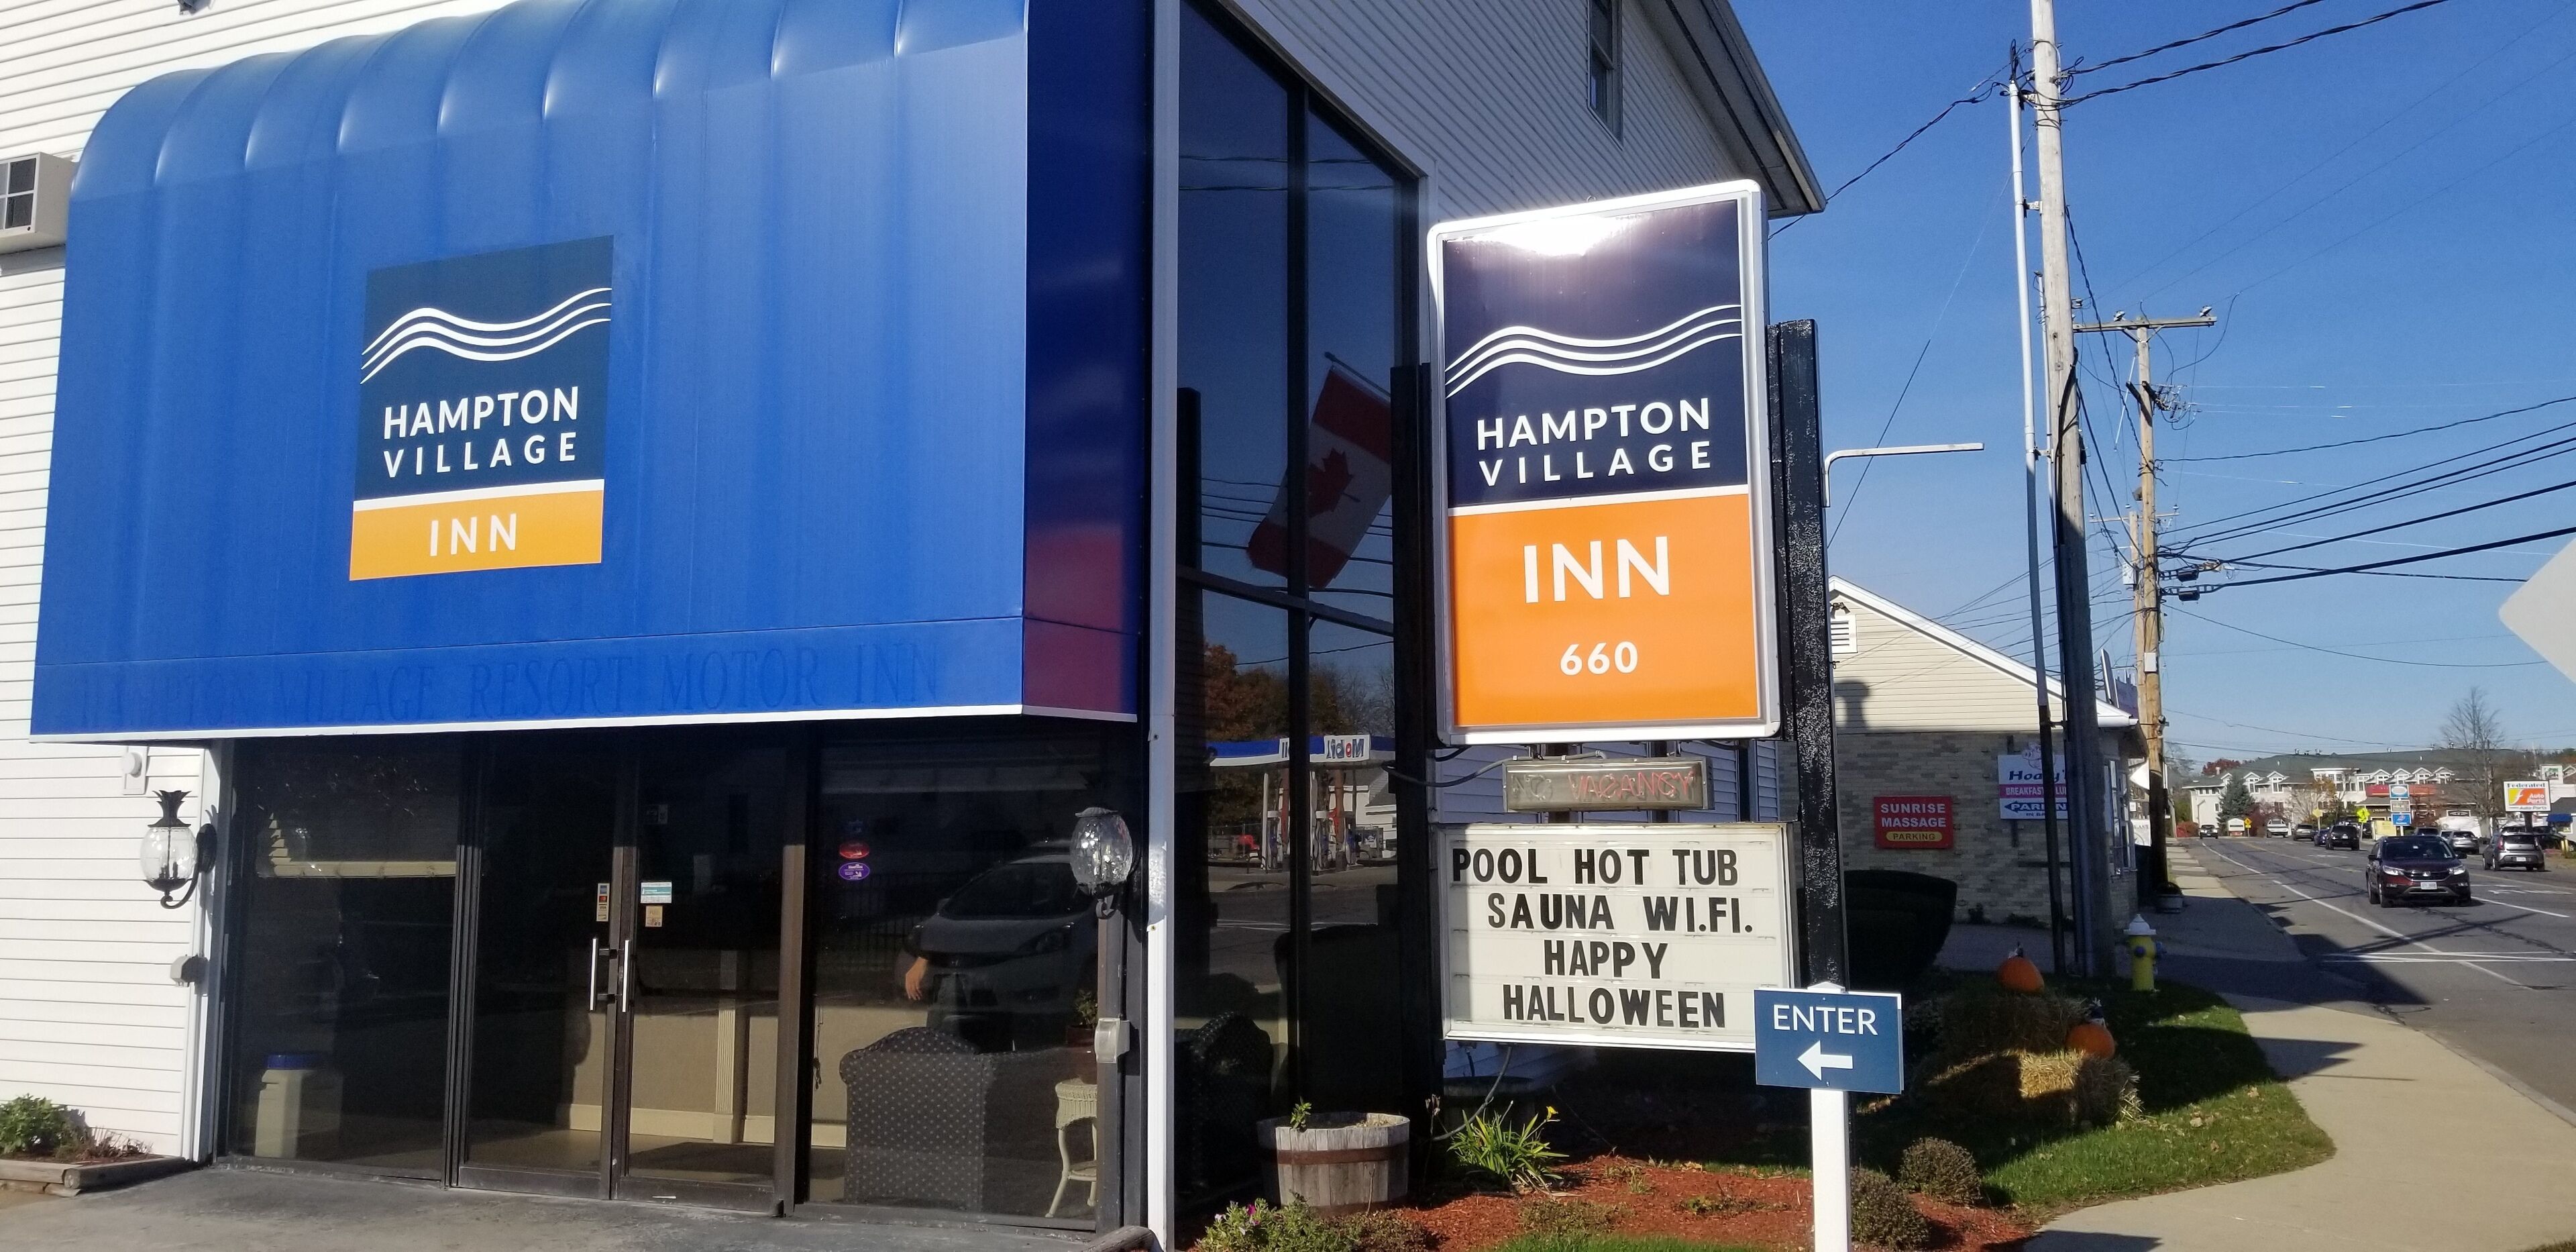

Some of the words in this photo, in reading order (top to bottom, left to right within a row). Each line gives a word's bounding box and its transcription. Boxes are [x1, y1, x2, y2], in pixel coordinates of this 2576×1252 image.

[384, 386, 578, 439] HAMPTON
[1477, 397, 1711, 452] HAMPTON
[384, 431, 577, 478] VILLAGE
[1479, 440, 1712, 487] VILLAGE
[429, 513, 517, 557] INN
[1523, 536, 1671, 605] INN
[1559, 641, 1639, 676] 660
[275, 662, 435, 723] VILLAGE
[468, 656, 632, 719] RESORT
[659, 647, 824, 711] MOTOR
[853, 641, 939, 704] INN
[1511, 774, 1553, 800] NO
[1568, 771, 1695, 802] VACANCY
[1880, 803, 1946, 814] SUNRISE
[1881, 817, 1947, 827] MASSAGE
[1892, 833, 1936, 841] PARKING
[1452, 847, 1548, 884] POOL
[1574, 848, 1650, 885] HOT
[1672, 849, 1738, 886] TUB
[1487, 892, 1615, 930] SAUNA
[1643, 896, 1753, 933] WI.FI.
[1544, 939, 1668, 980] HAPPY
[1503, 984, 1726, 1029] HALLOWEEN
[1773, 1004, 1878, 1036] ENTER
